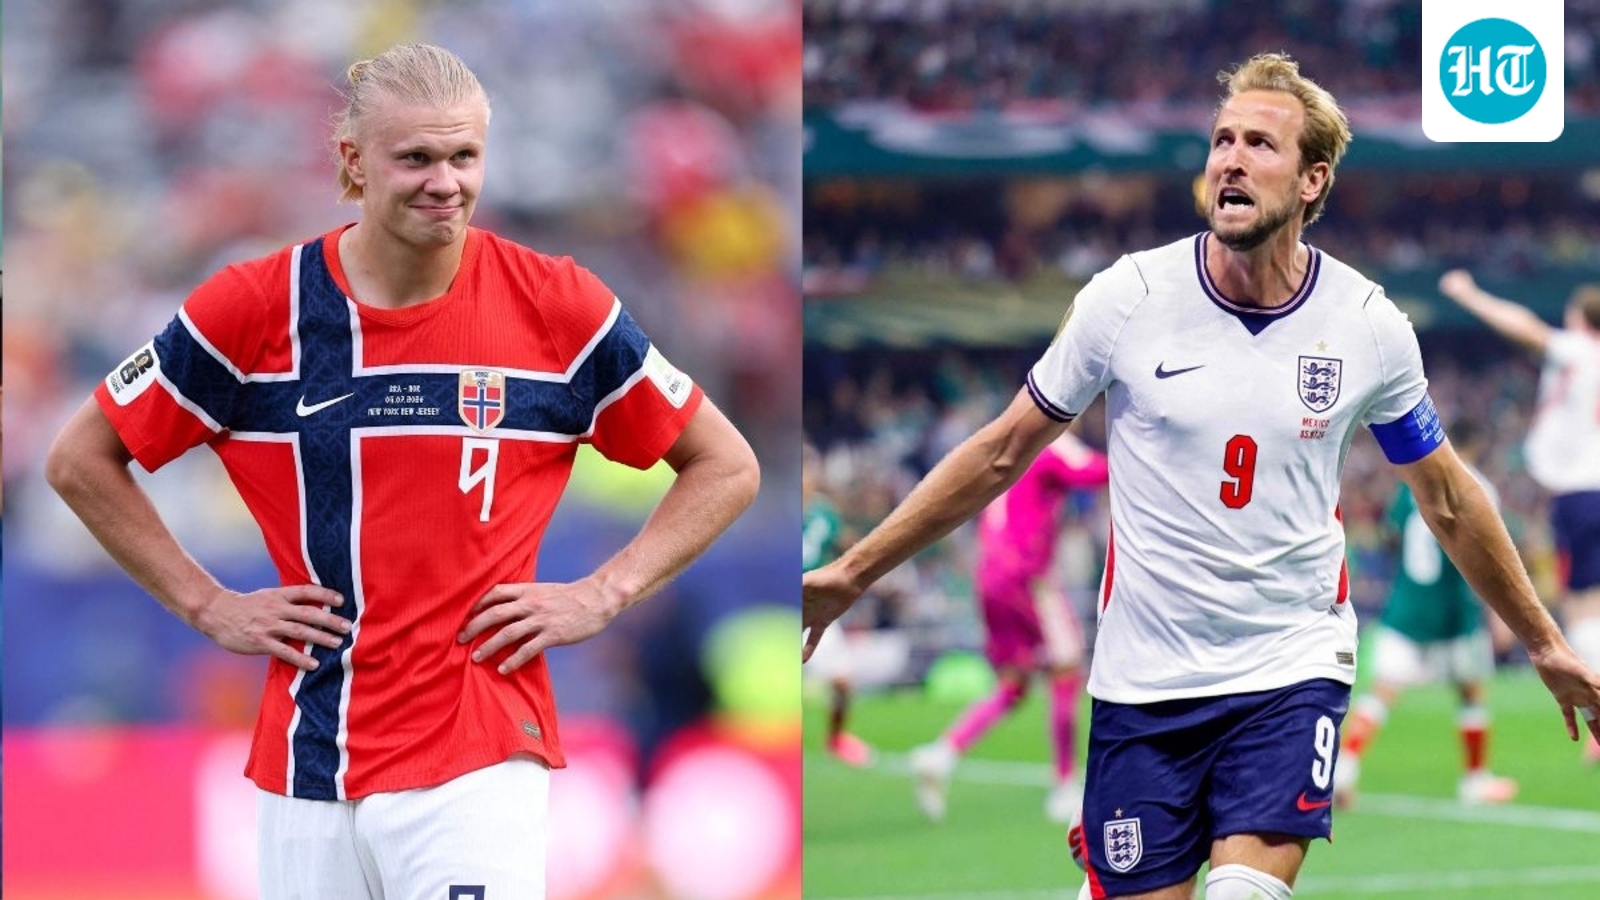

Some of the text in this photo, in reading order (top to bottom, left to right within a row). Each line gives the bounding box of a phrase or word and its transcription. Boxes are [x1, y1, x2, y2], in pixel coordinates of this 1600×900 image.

[367, 407, 441, 416] NEW YORK NEW JERSEY
[1302, 417, 1330, 429] MEXICO
[458, 437, 499, 522] 9
[1220, 434, 1258, 509] 9
[1312, 715, 1335, 790] 9
